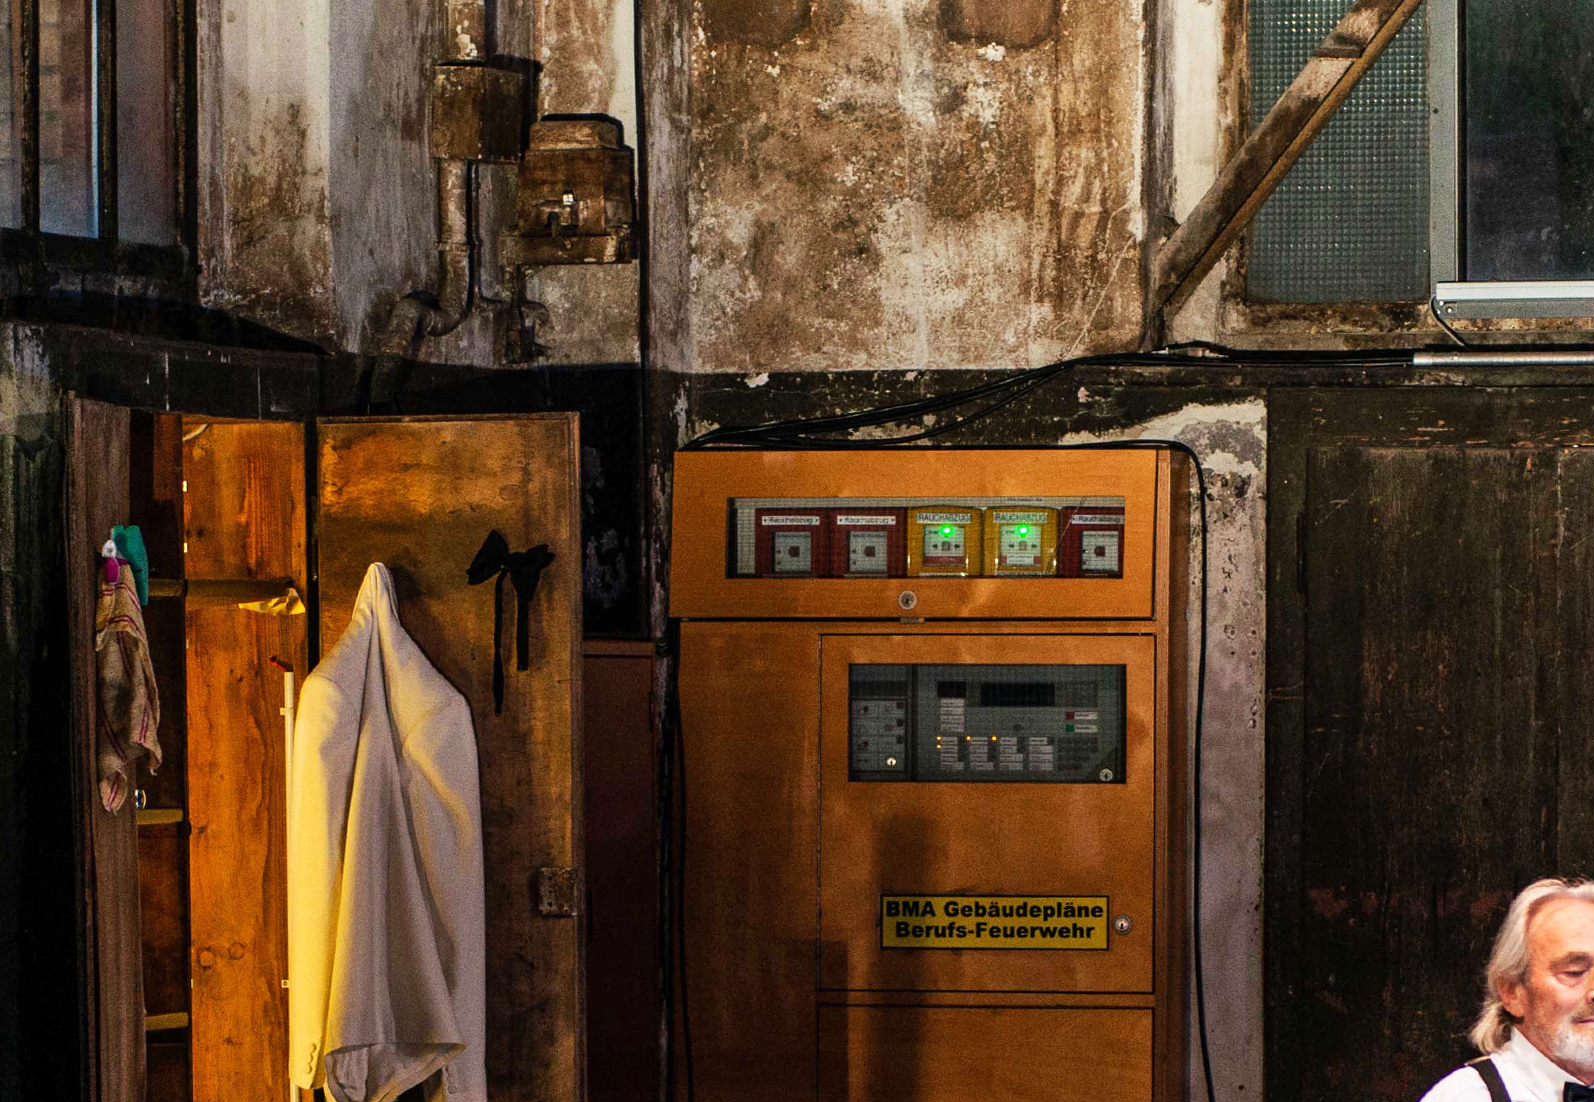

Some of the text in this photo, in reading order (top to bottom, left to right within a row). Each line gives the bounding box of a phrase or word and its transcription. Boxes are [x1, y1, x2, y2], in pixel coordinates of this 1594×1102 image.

[887, 901, 1104, 921] BMA Gebäudepläne
[895, 922, 1095, 939] Berufs-Feuerwehr
